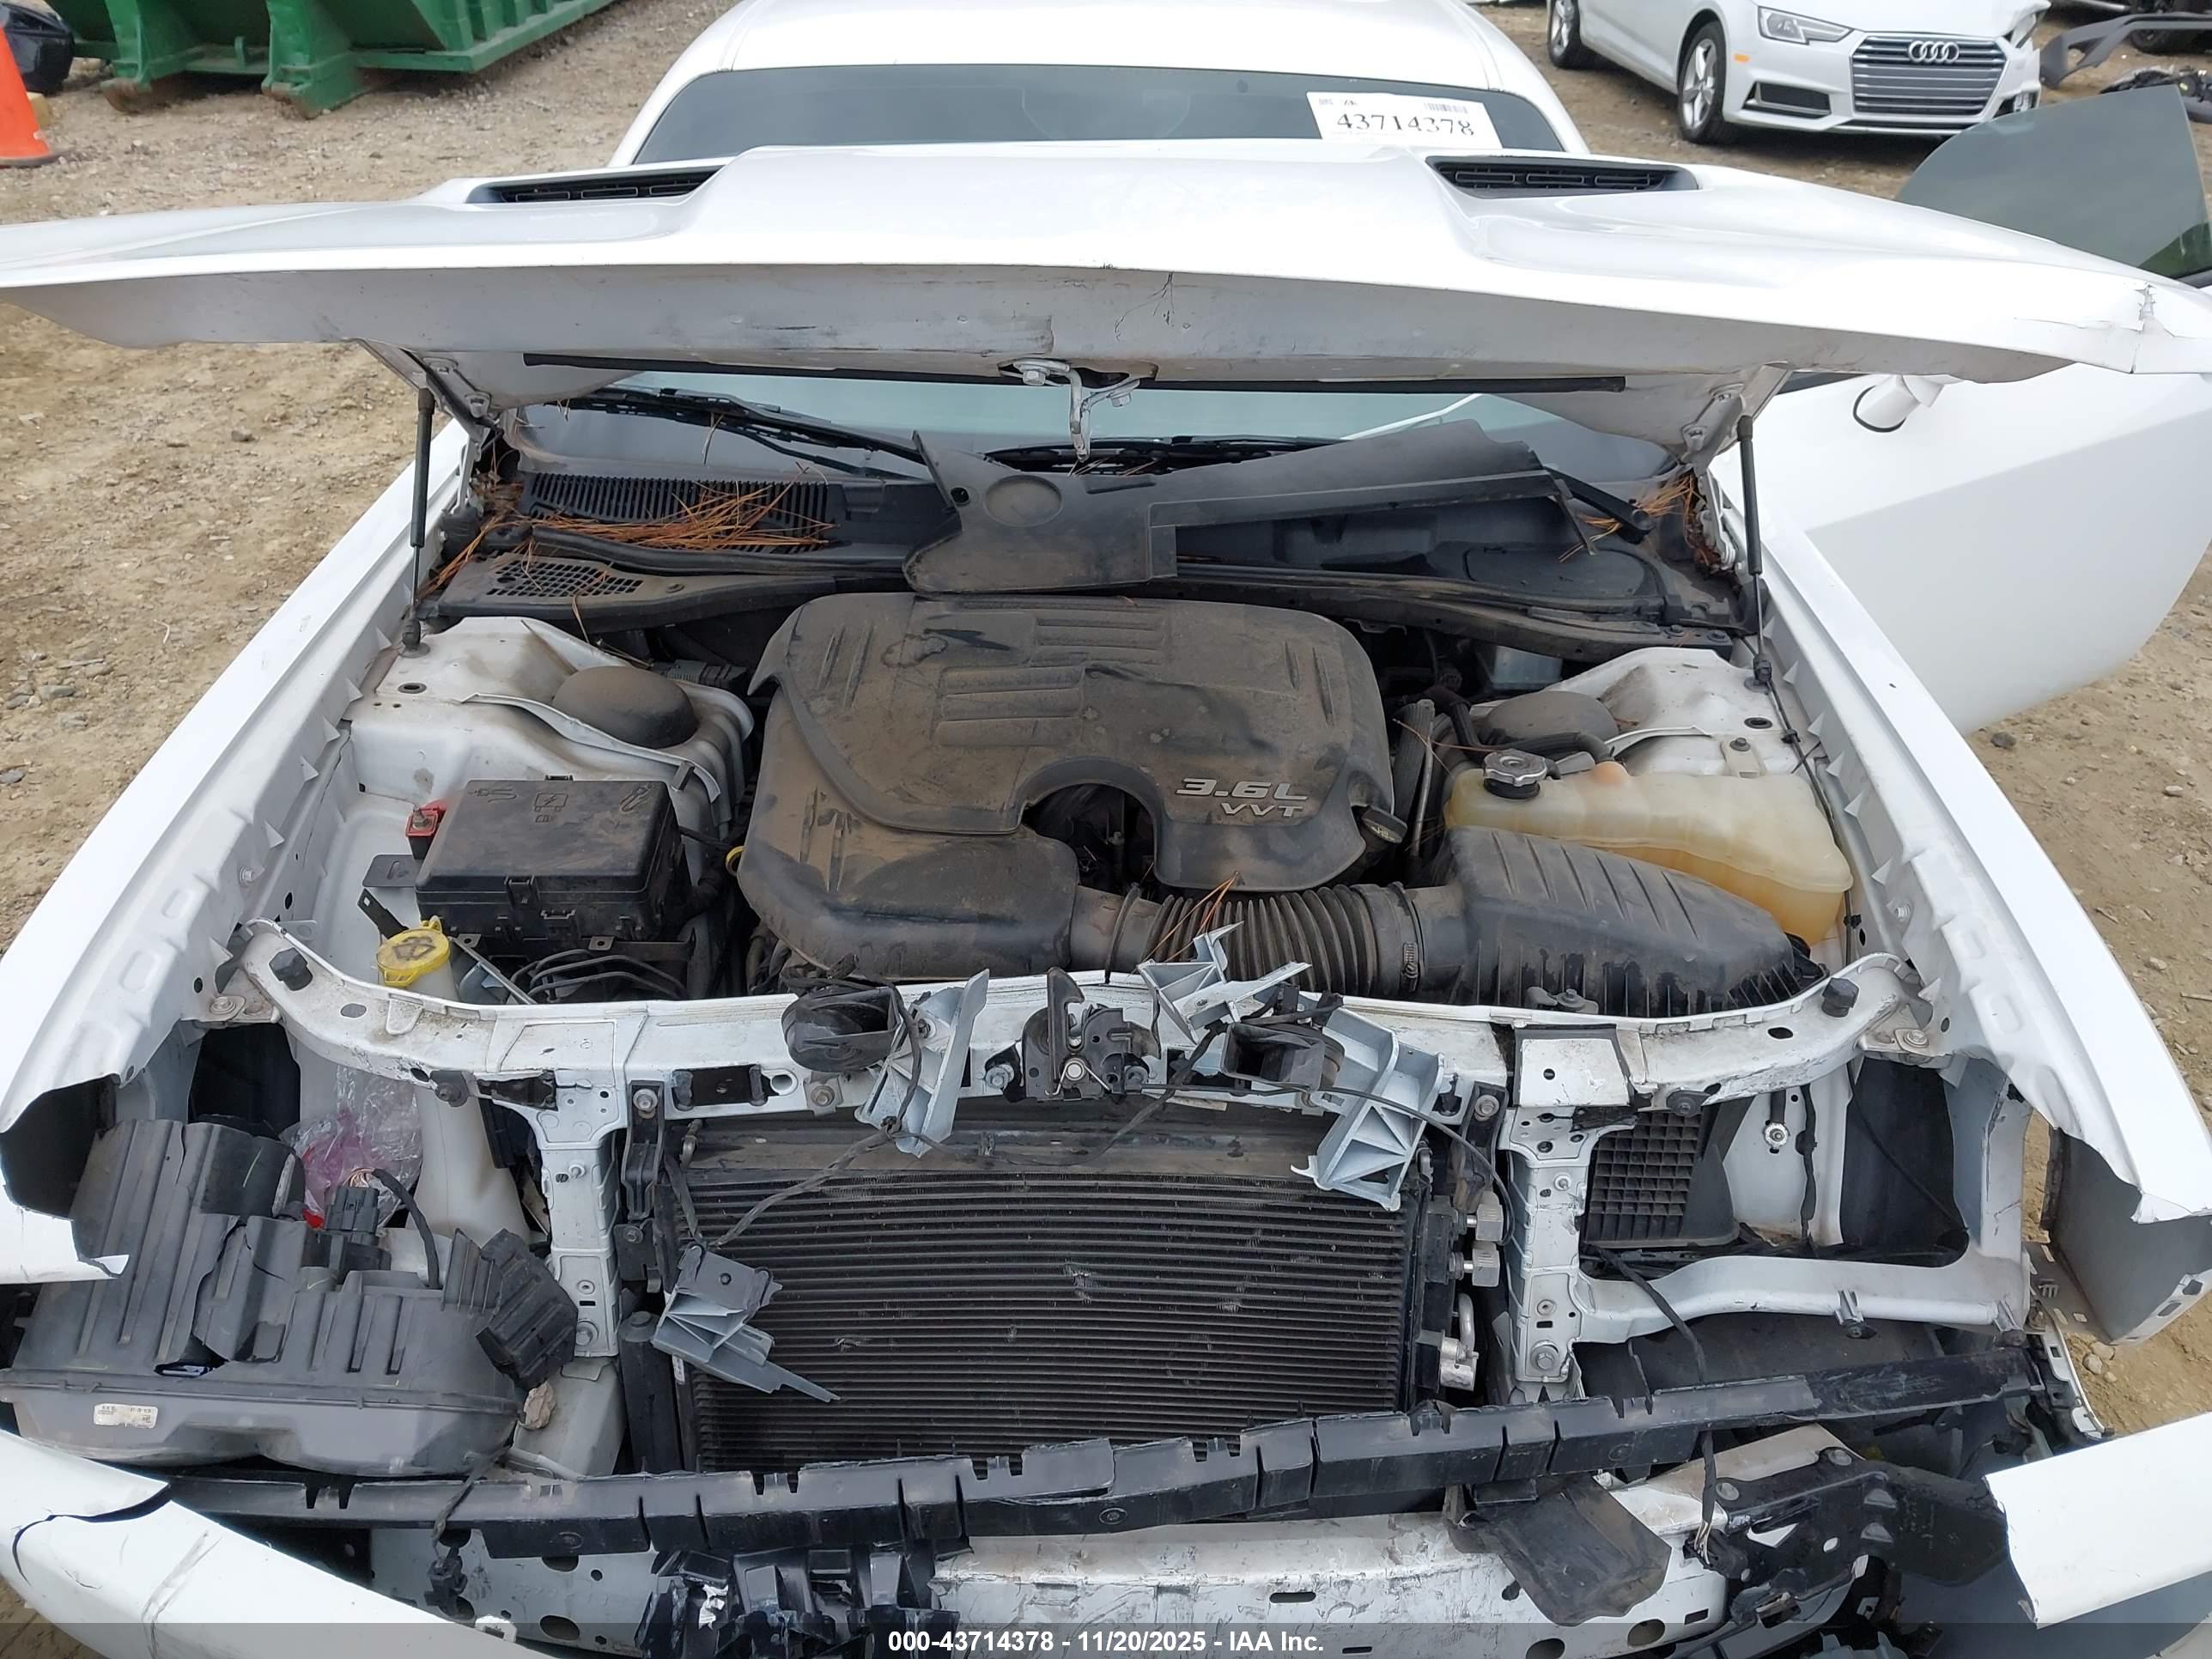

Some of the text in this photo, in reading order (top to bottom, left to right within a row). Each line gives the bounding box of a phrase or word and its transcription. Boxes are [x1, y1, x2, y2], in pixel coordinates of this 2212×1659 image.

[1337, 113, 1474, 136] 43714378
[1176, 777, 1309, 800] 3.6L
[1220, 802, 1304, 817] VVT
